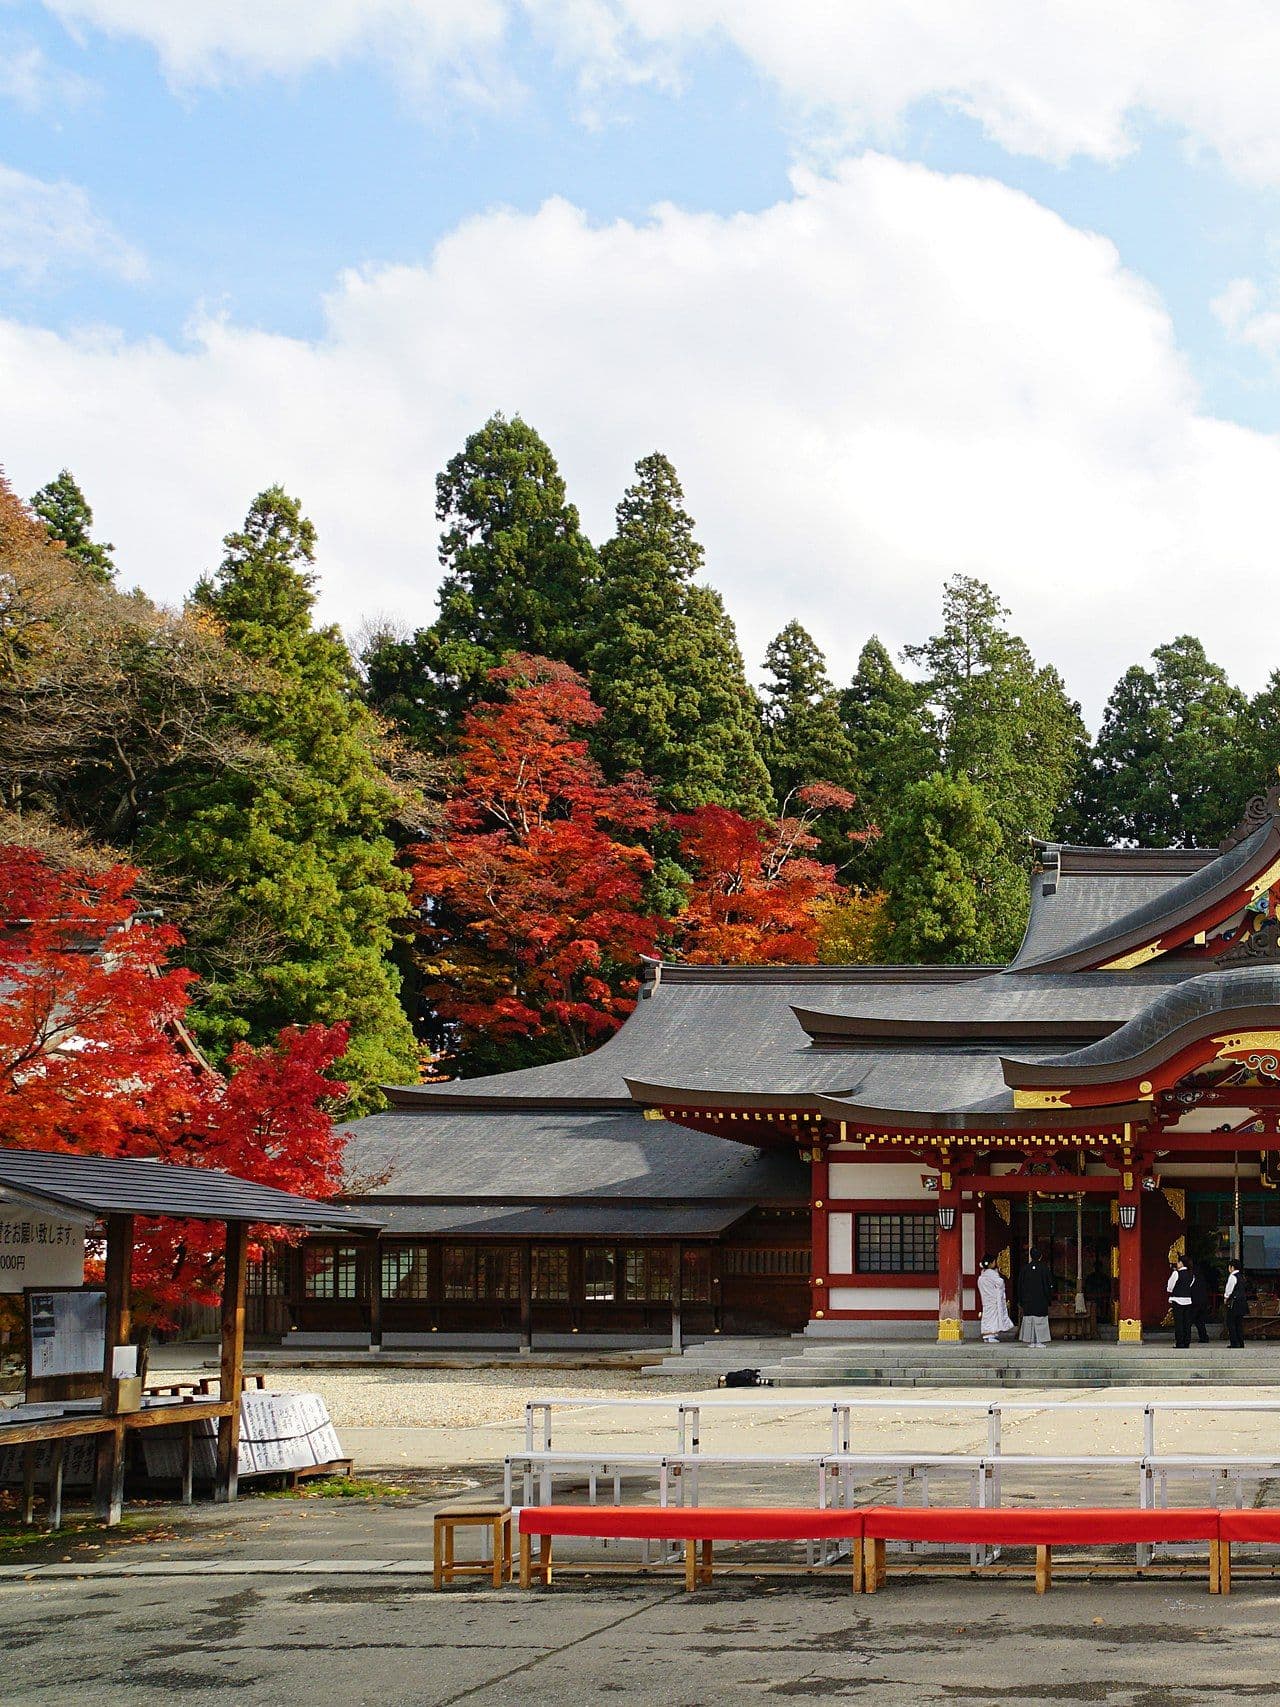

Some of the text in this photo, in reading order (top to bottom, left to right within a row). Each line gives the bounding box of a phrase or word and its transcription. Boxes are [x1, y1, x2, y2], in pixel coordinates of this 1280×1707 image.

[0, 1222, 77, 1246] をお願い致します。
